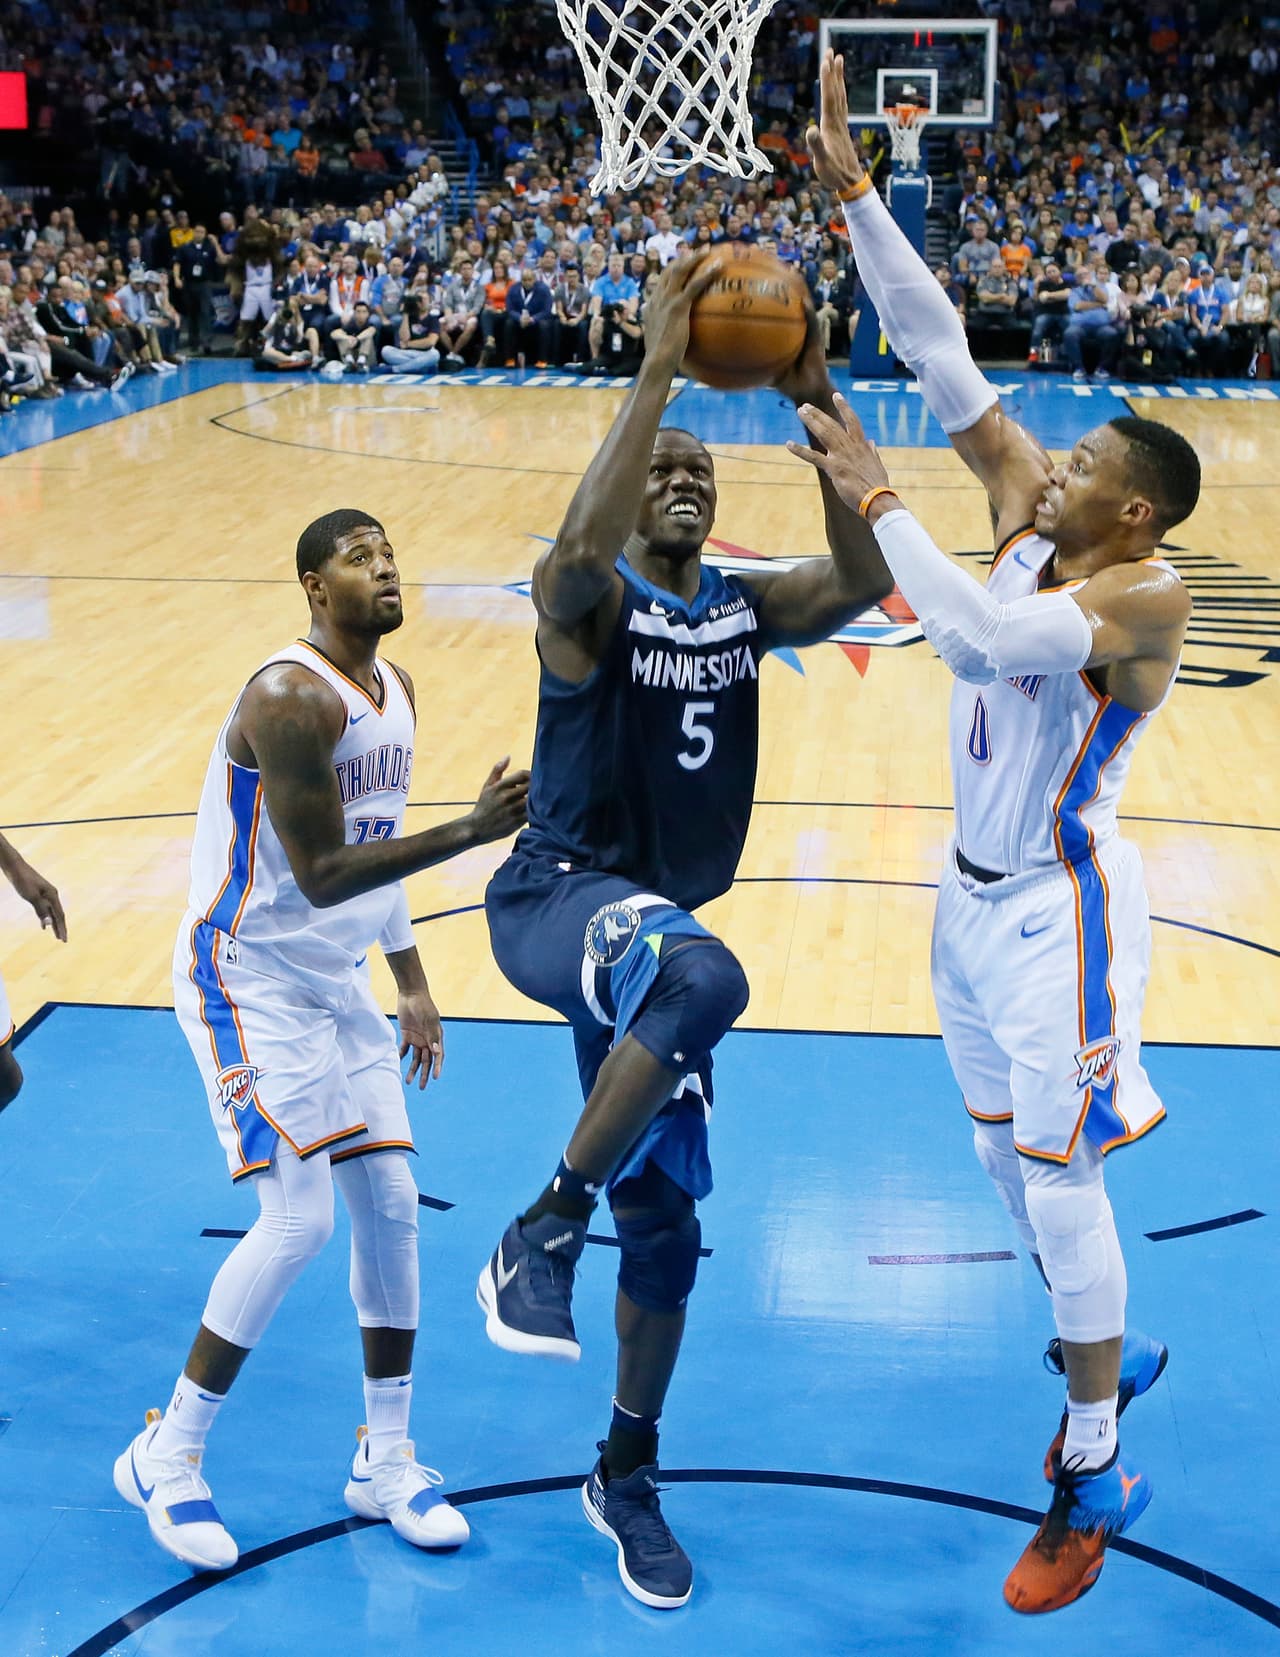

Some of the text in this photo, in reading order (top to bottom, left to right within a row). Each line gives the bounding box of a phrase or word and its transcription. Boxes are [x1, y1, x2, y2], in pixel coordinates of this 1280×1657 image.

[720, 596, 748, 617] fitbit
[631, 646, 758, 693] MINNESOTA
[677, 702, 715, 771] 5
[1078, 1044, 1113, 1086] OKC
[222, 1071, 248, 1106] OKC
